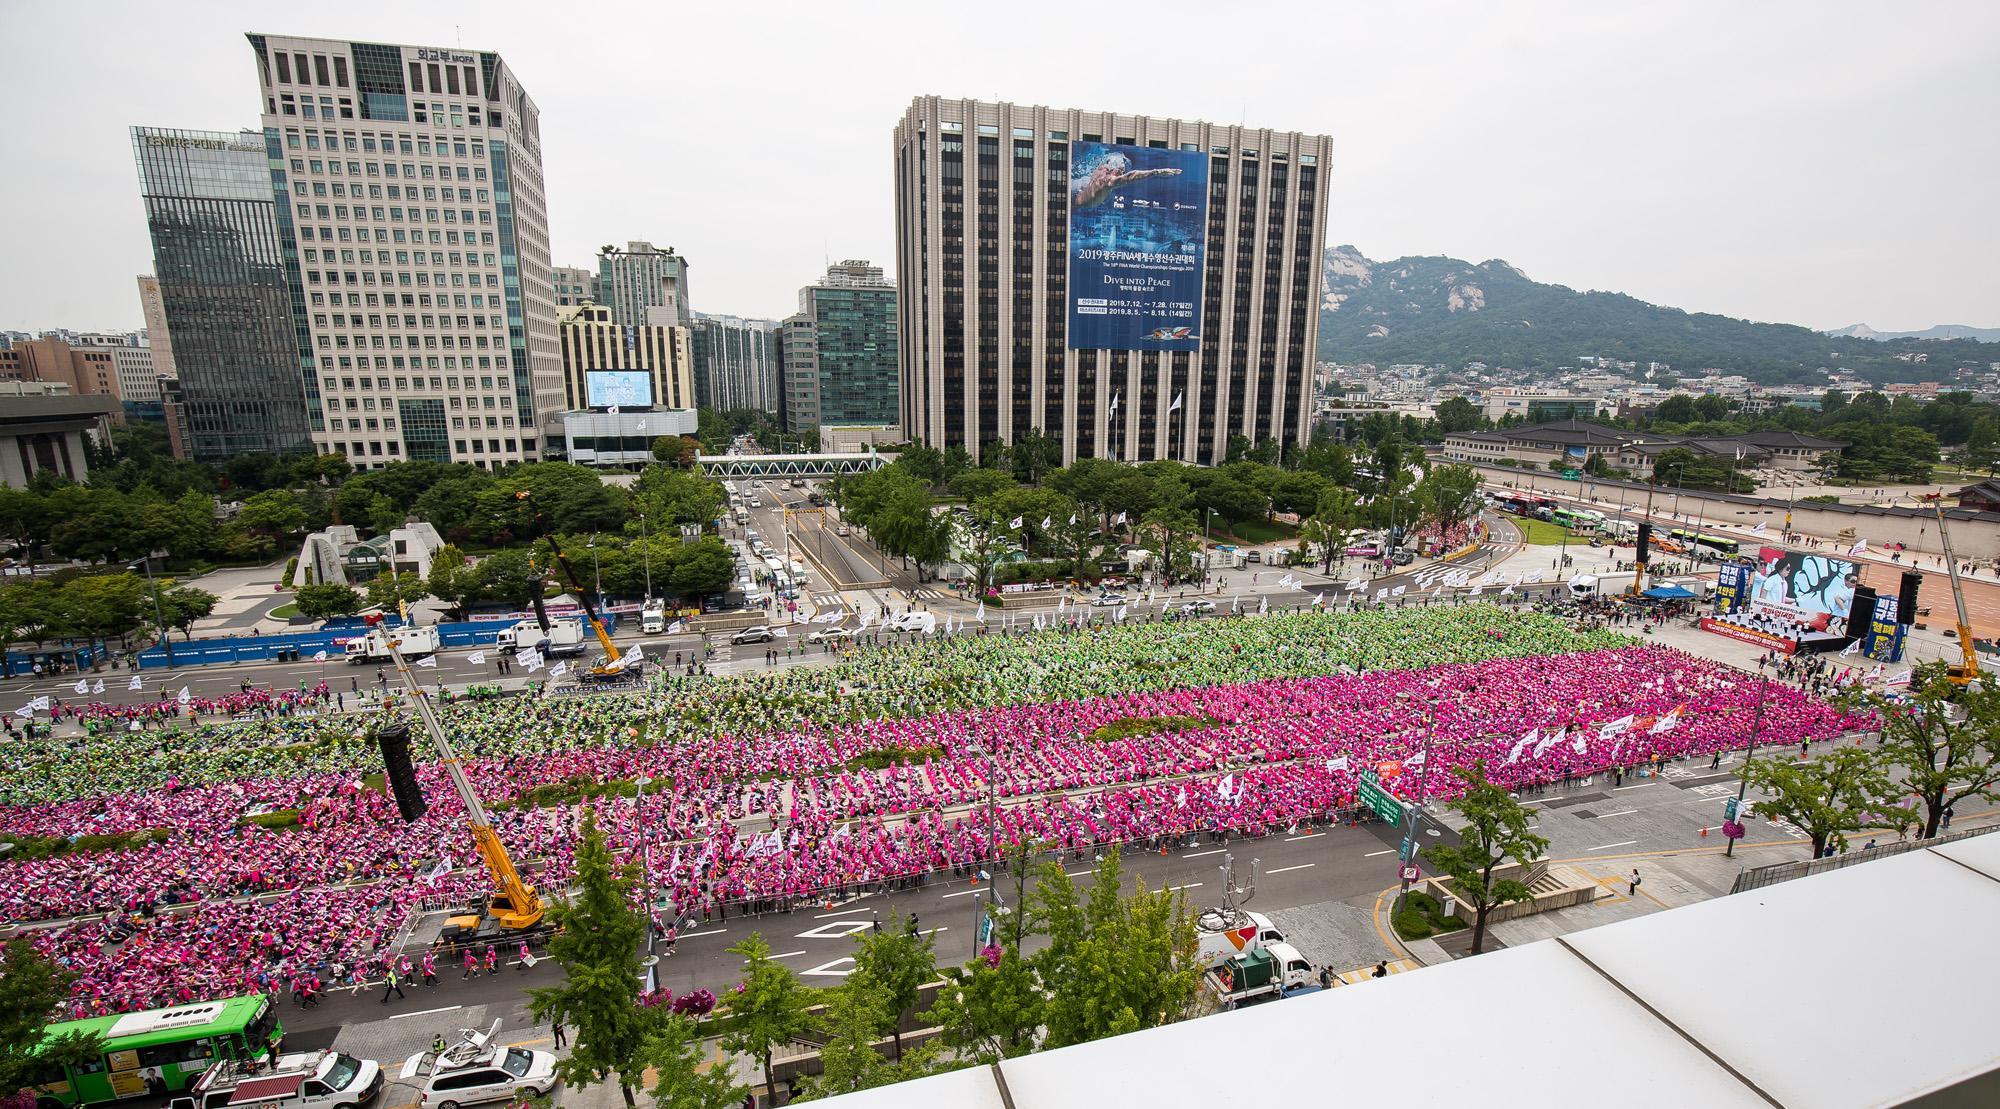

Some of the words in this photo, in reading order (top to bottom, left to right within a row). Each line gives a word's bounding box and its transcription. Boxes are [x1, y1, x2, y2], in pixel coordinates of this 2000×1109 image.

[418, 49, 451, 62] 외교부
[452, 55, 474, 63] MOFA
[1721, 565, 1739, 577] 최저
[1720, 574, 1737, 586] 임금
[1717, 586, 1735, 597] 1만원
[1877, 597, 1898, 612] 비정
[1872, 621, 1896, 636] 철폐
